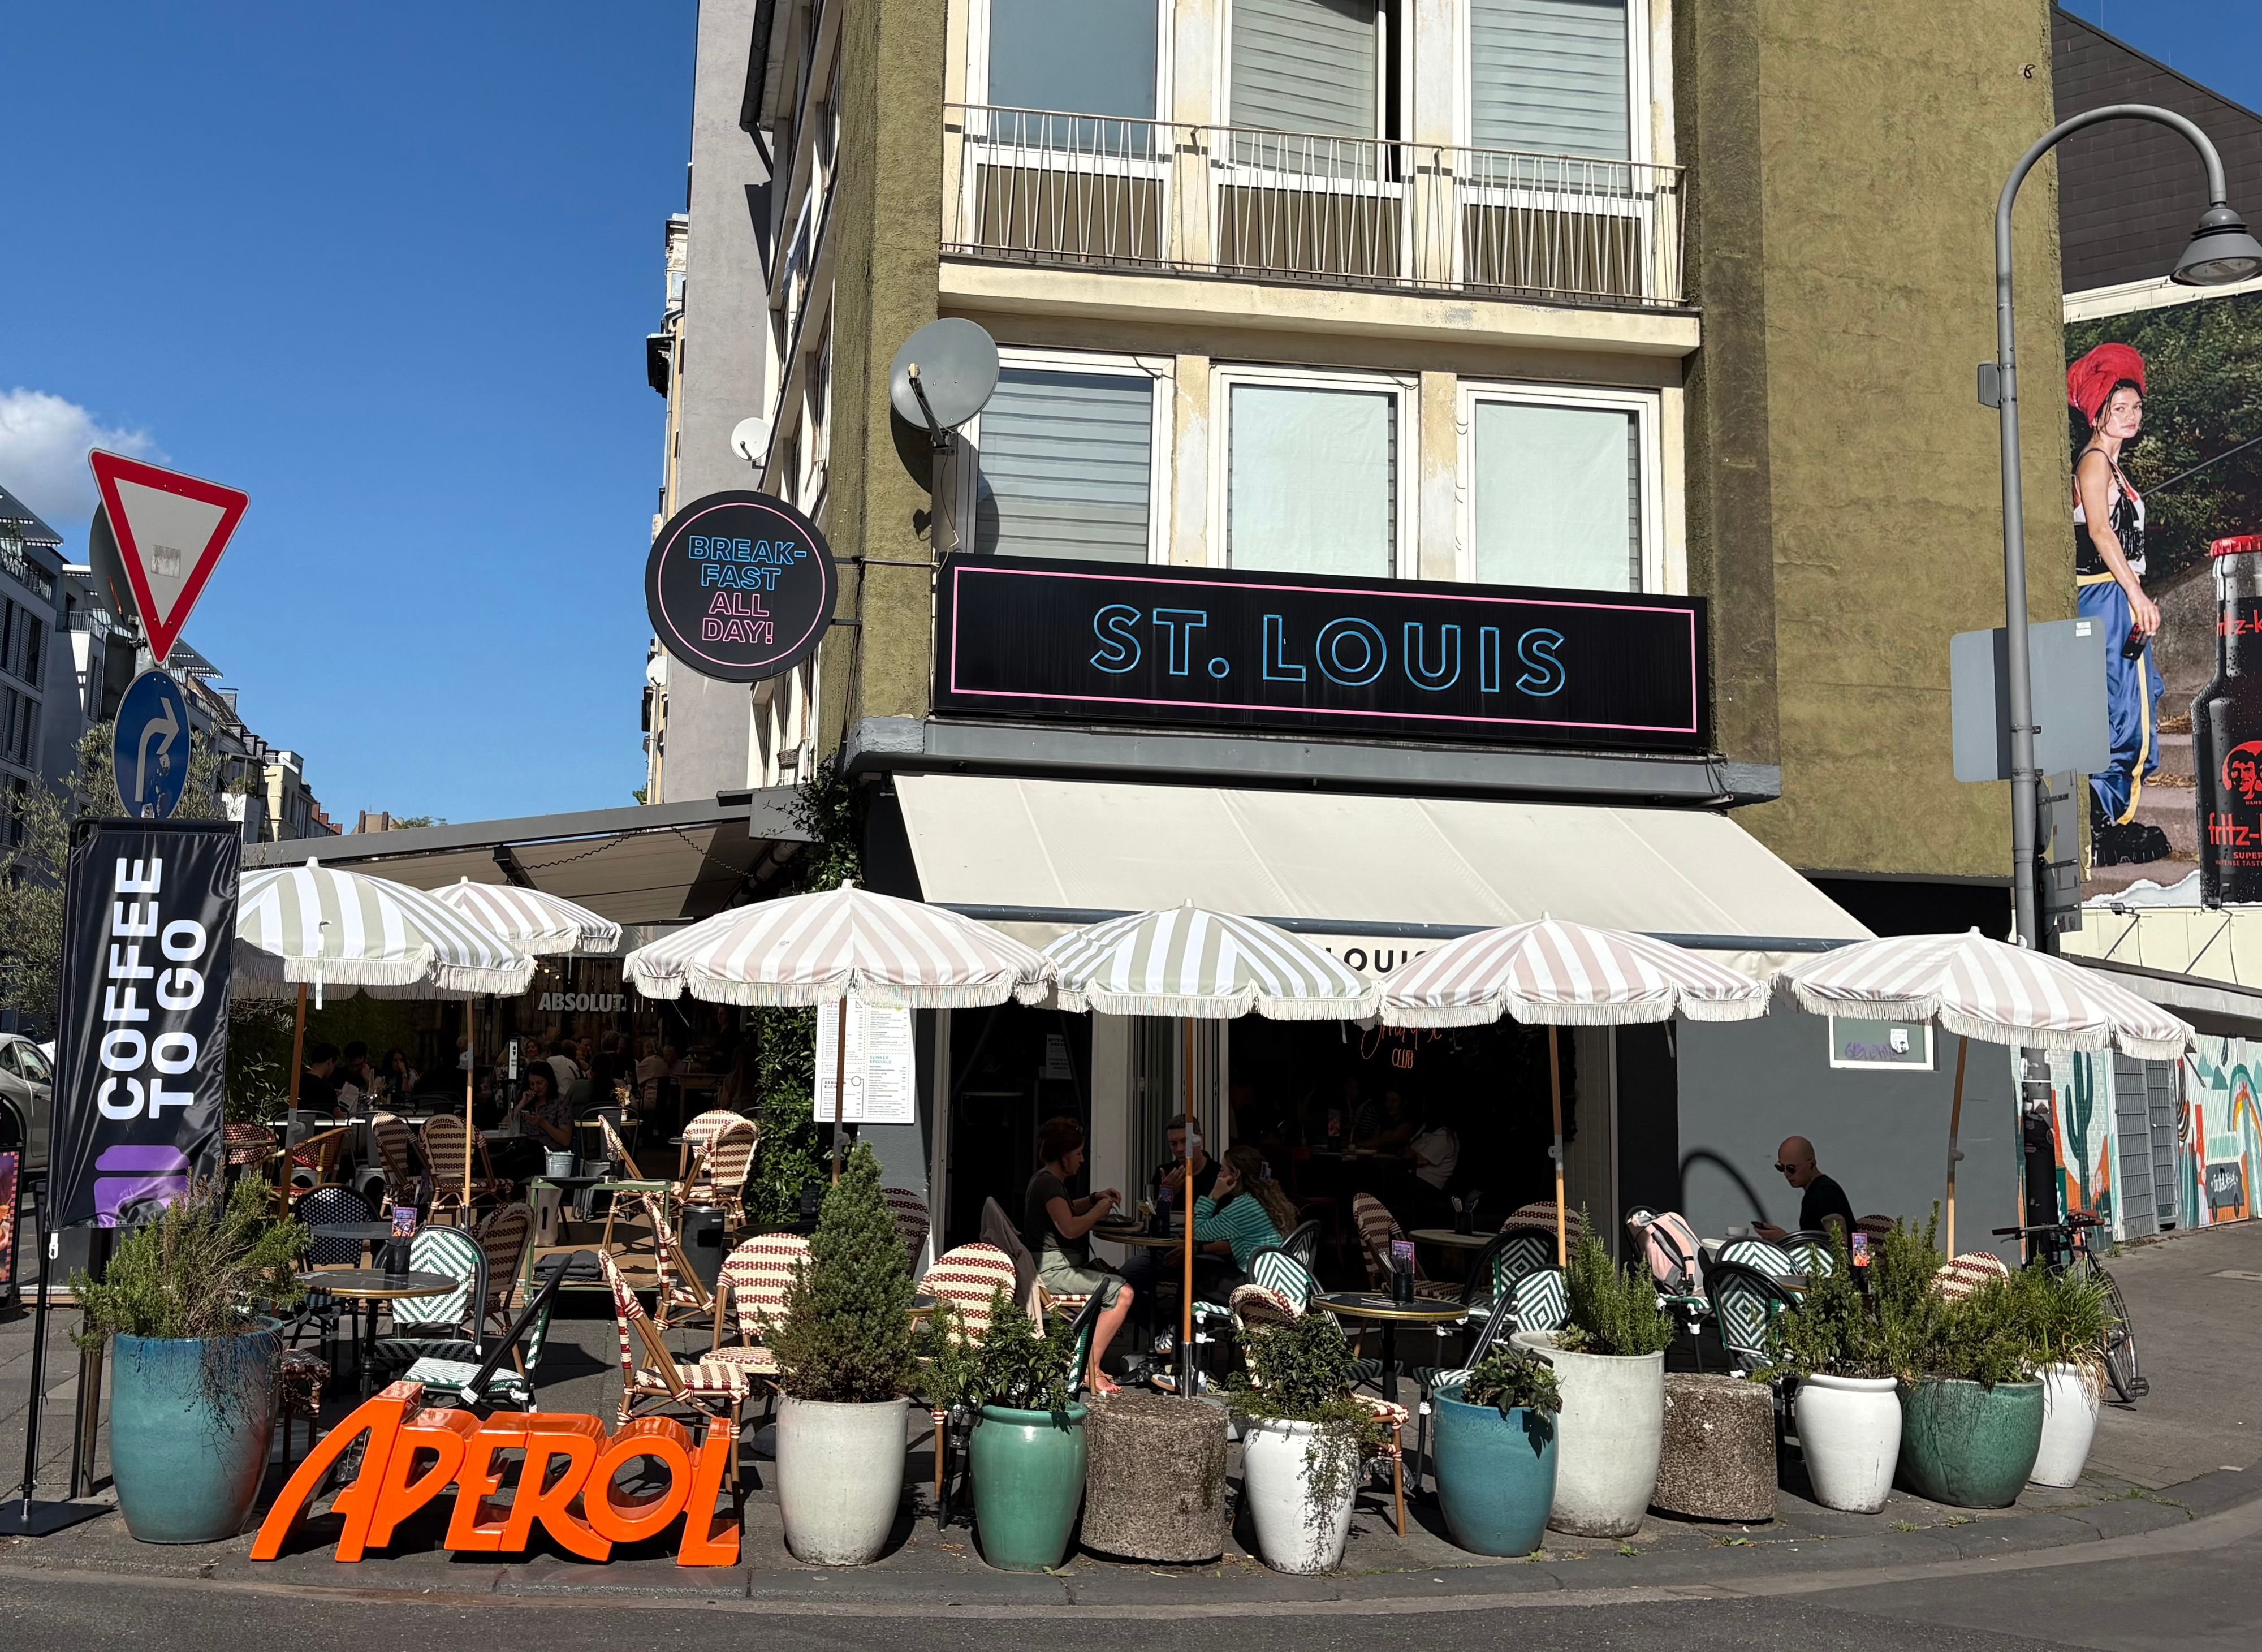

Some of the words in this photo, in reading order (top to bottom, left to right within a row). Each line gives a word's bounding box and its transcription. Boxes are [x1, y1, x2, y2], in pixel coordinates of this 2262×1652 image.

[688, 535, 807, 564] BREAK-
[701, 563, 782, 590] FAST
[709, 592, 770, 617] ALL
[702, 618, 774, 644] DAY!
[1090, 603, 1230, 679] ST.
[1262, 614, 1566, 697] LOUIS
[2208, 812, 2262, 846] fritz-
[156, 919, 207, 1011] GO
[1325, 947, 1427, 973] OUI
[97, 857, 162, 1120] COFFEE
[1392, 1047, 1414, 1068] CLUB
[148, 1032, 198, 1119] TO
[249, 1380, 740, 1567] APEROL
